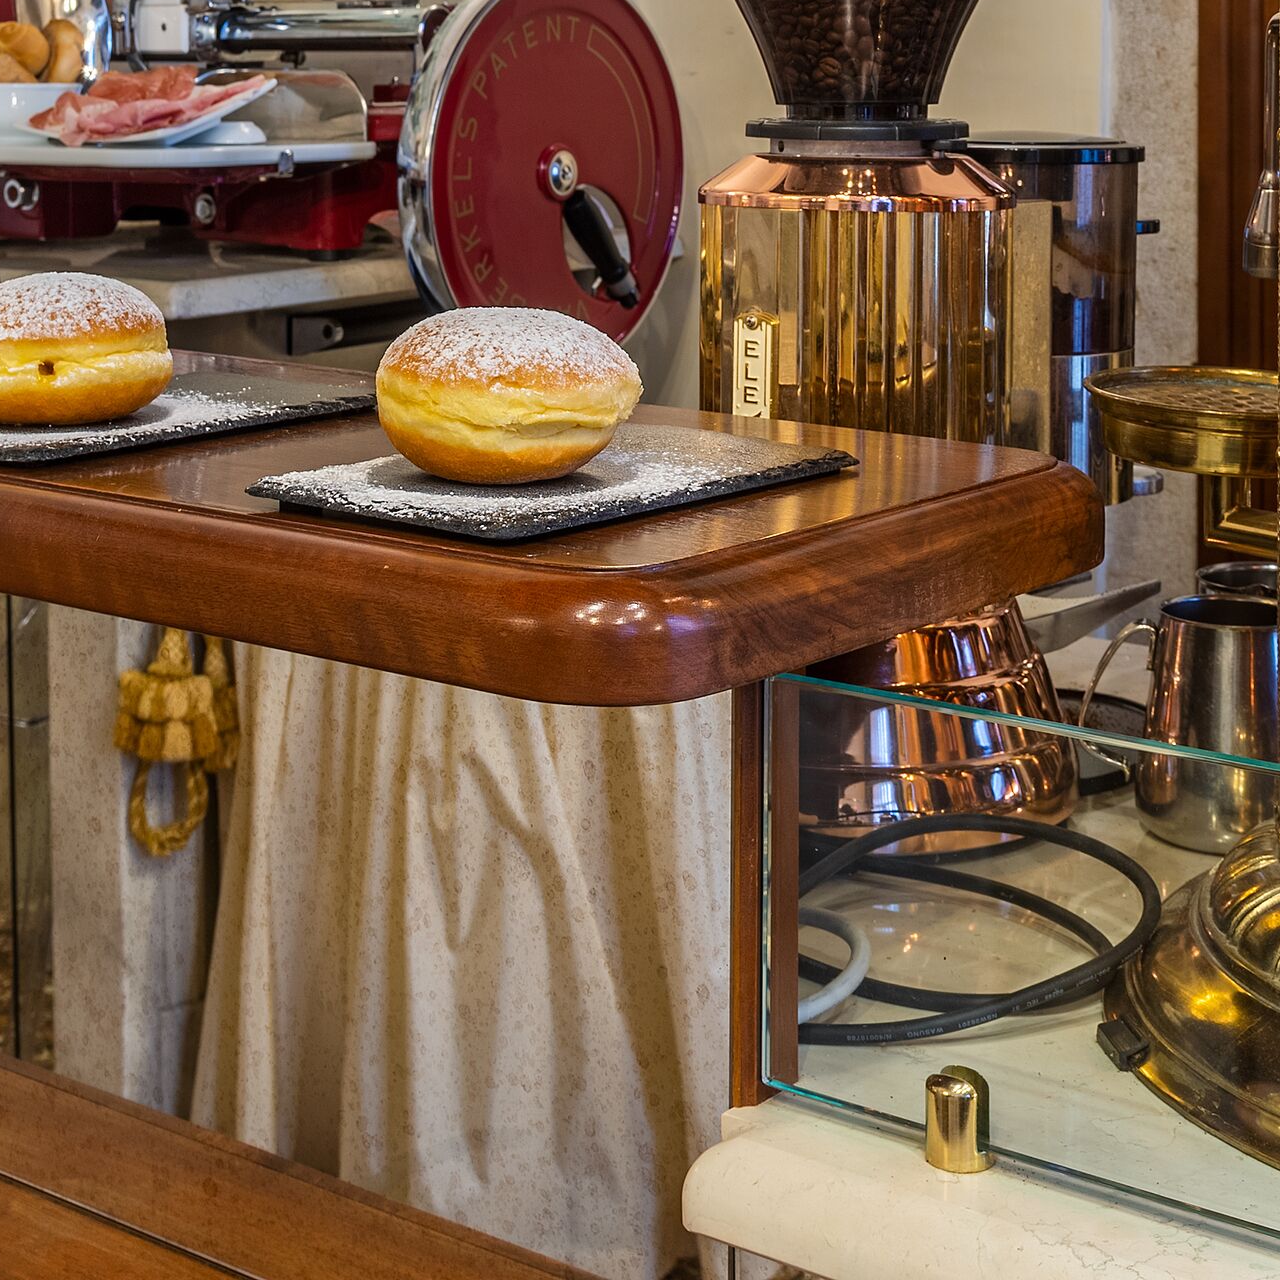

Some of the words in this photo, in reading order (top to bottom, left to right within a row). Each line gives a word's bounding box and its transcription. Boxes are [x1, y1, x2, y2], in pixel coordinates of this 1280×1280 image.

[471, 15, 581, 100] PATENT
[743, 340, 761, 417] ELE
[907, 1027, 944, 1038] WASUNG
